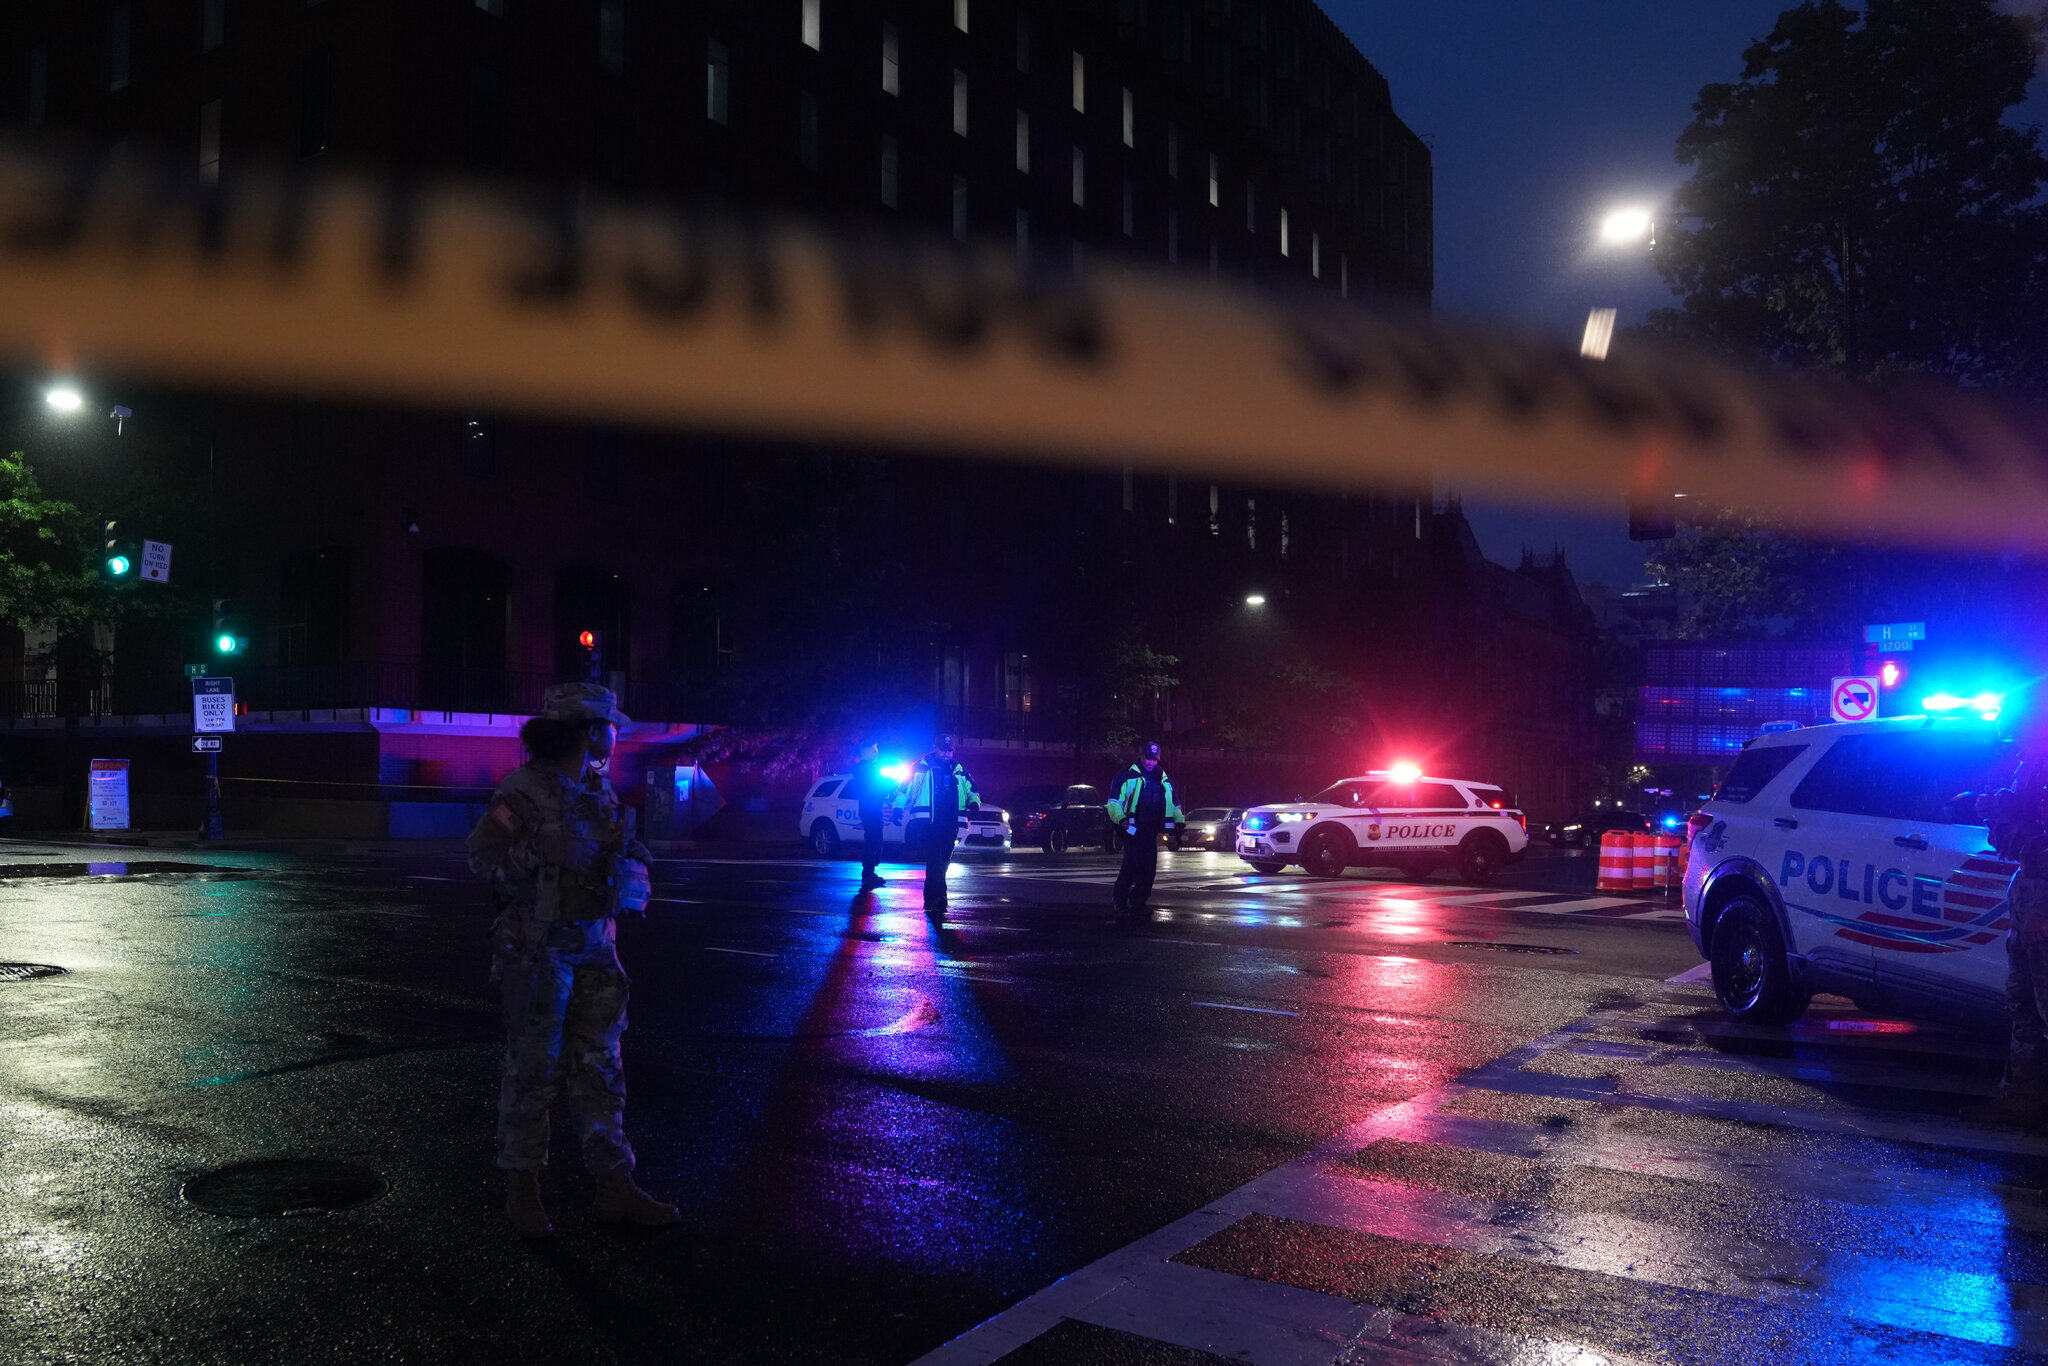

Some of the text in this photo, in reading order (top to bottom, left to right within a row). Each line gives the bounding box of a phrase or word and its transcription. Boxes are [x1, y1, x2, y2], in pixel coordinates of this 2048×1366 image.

[151, 543, 164, 552] NO
[149, 552, 165, 561] TURN
[1883, 627, 1891, 639] H
[202, 703, 226, 711] BIKES
[1386, 824, 1456, 839] POLICE
[1780, 850, 1943, 919] POLICE
